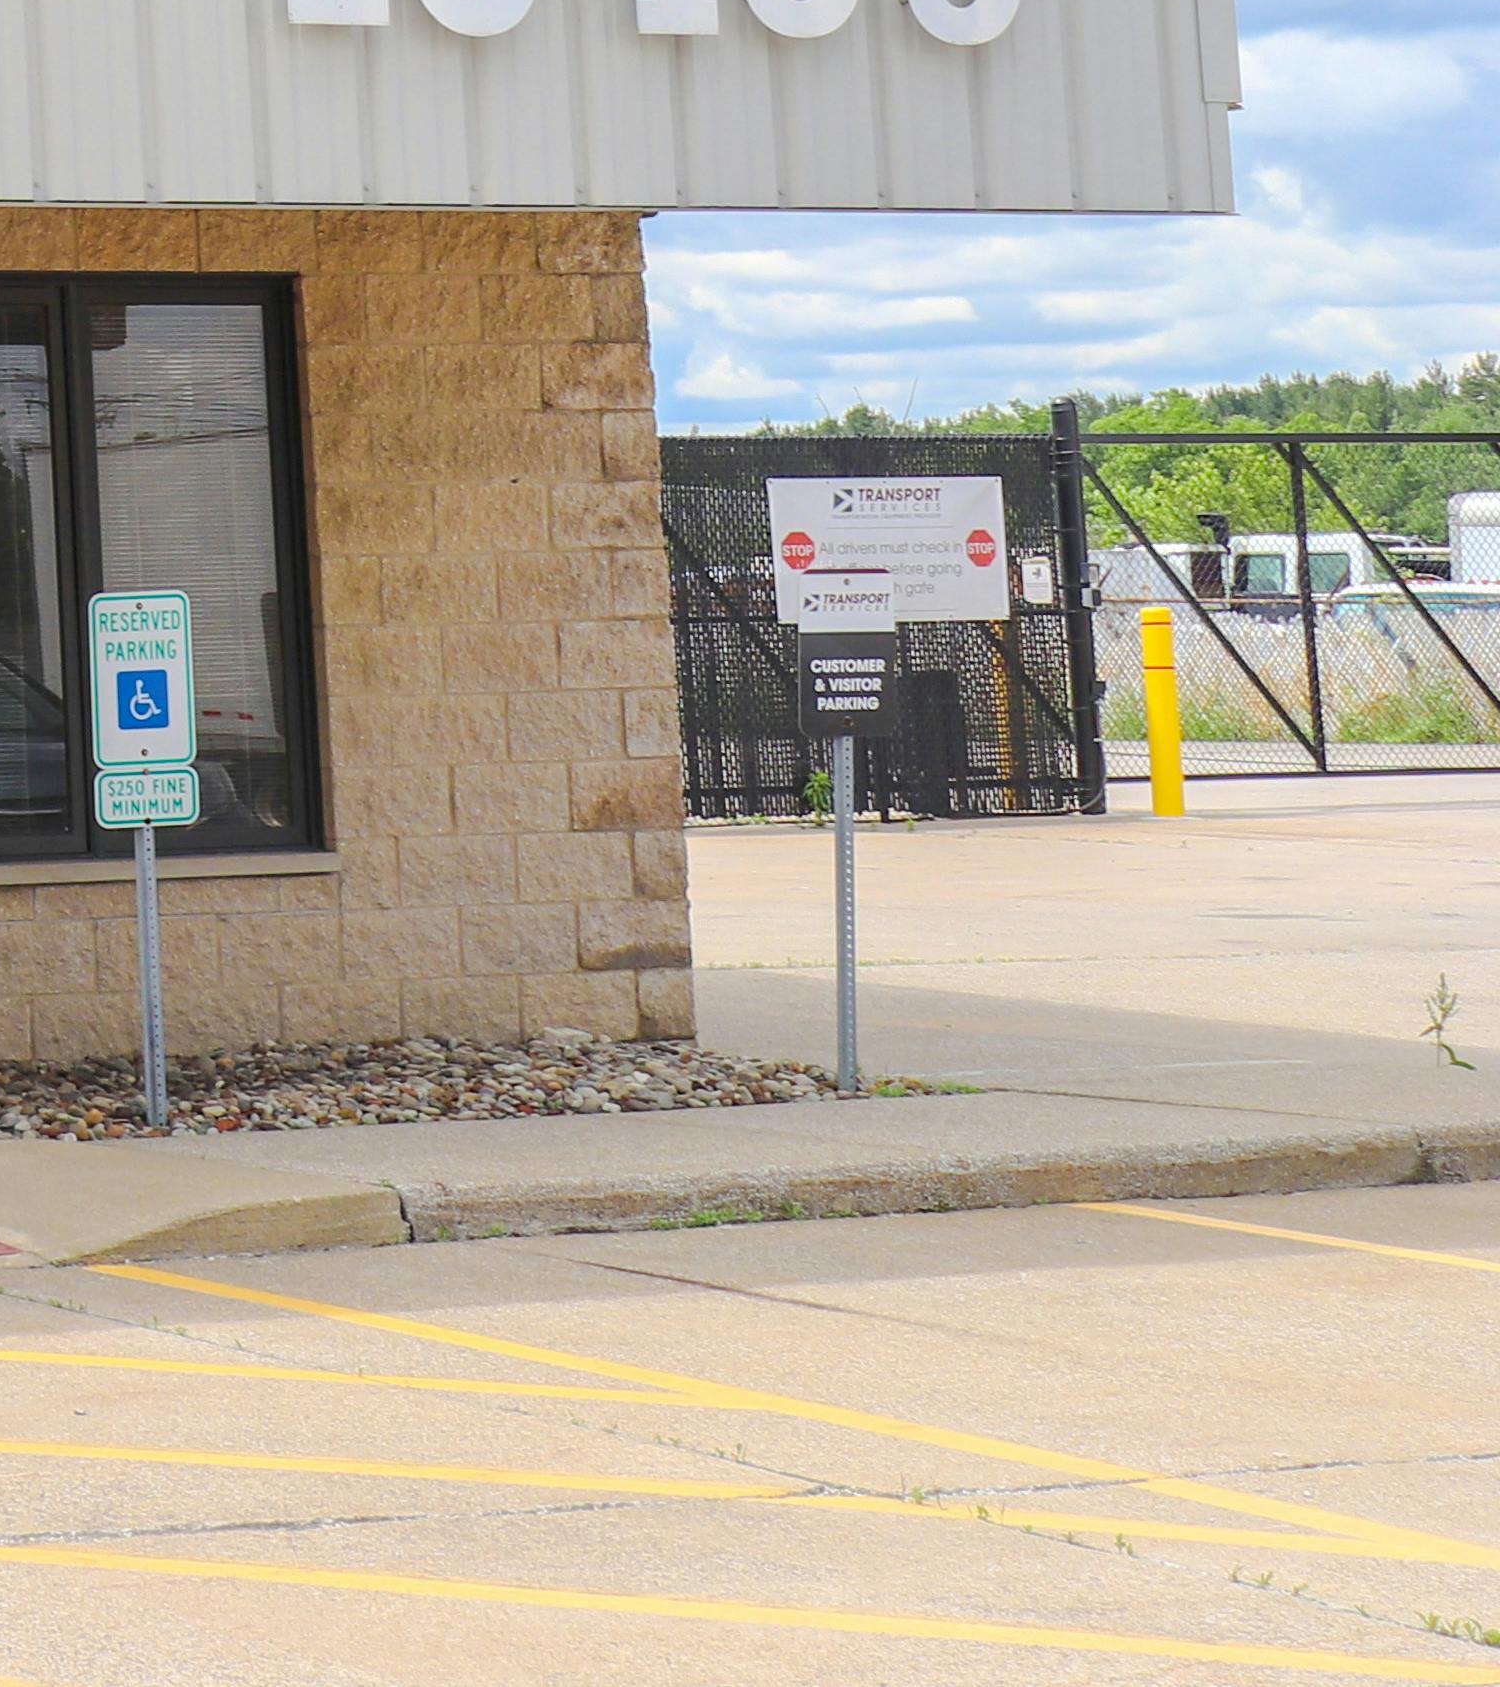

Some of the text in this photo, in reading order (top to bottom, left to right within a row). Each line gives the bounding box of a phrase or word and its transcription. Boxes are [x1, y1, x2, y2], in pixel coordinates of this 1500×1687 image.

[858, 487, 941, 502] TRANSPORT
[859, 502, 941, 512] SERVICES
[781, 544, 814, 557] STOP
[819, 540, 963, 555] All drivers must check in
[967, 542, 996, 555] STOP
[926, 562, 963, 578] going
[904, 582, 935, 598] gate
[823, 592, 891, 604] TRANSPORT
[98, 609, 181, 632] RESERVED
[105, 638, 177, 662] PARKING
[810, 658, 886, 673] CUSTOMER
[814, 678, 882, 692] & VISITOR
[817, 696, 880, 711] PARKING
[107, 777, 187, 797] $250 FINE
[112, 797, 184, 817] MINIMUM
